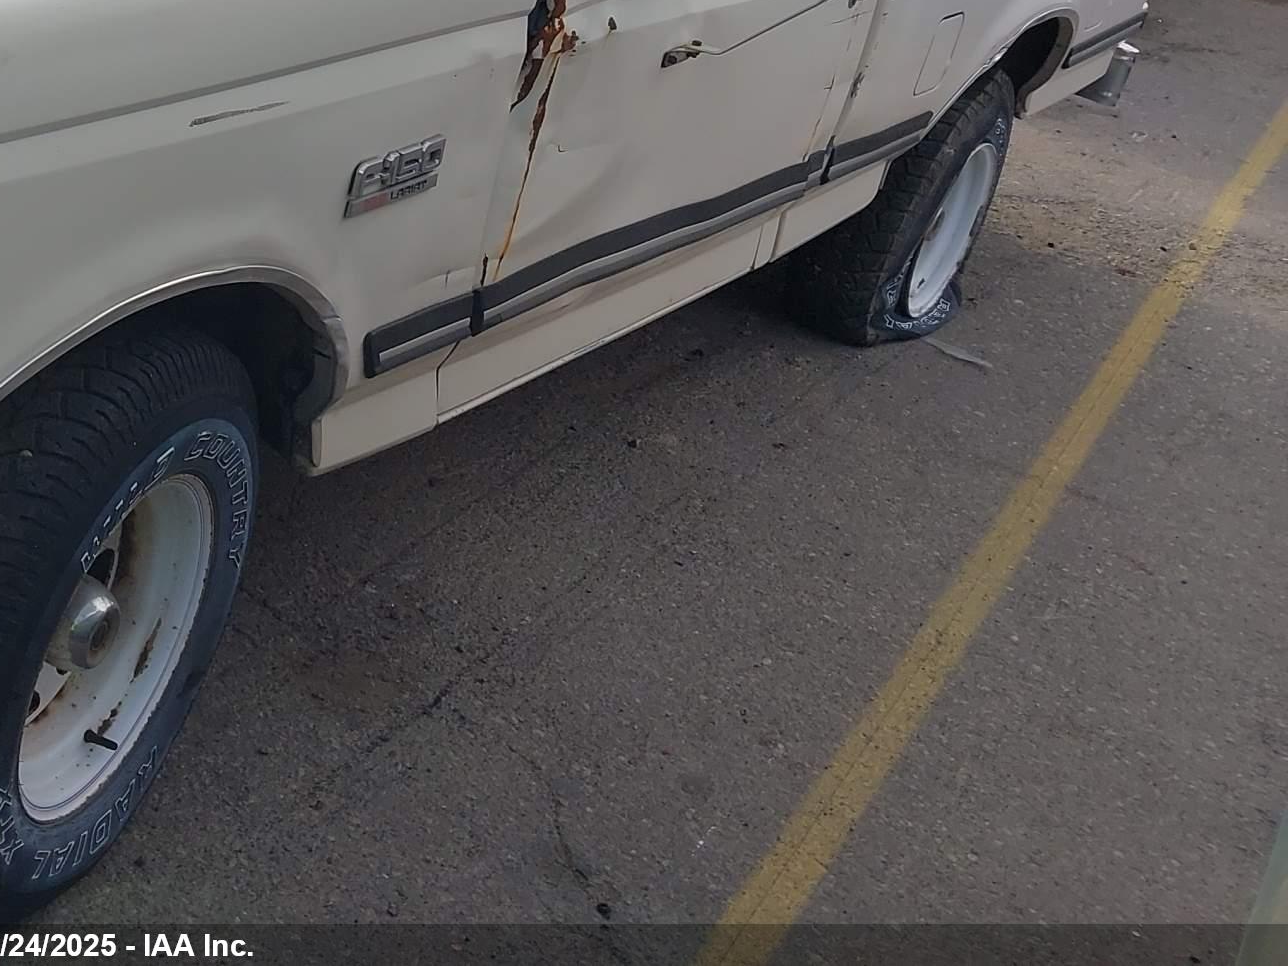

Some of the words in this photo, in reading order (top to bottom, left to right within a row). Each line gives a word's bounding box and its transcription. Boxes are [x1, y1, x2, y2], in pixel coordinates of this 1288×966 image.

[390, 179, 429, 201] LARIAT
[183, 430, 250, 570] COUNTRY
[31, 745, 159, 881] RADIAL
